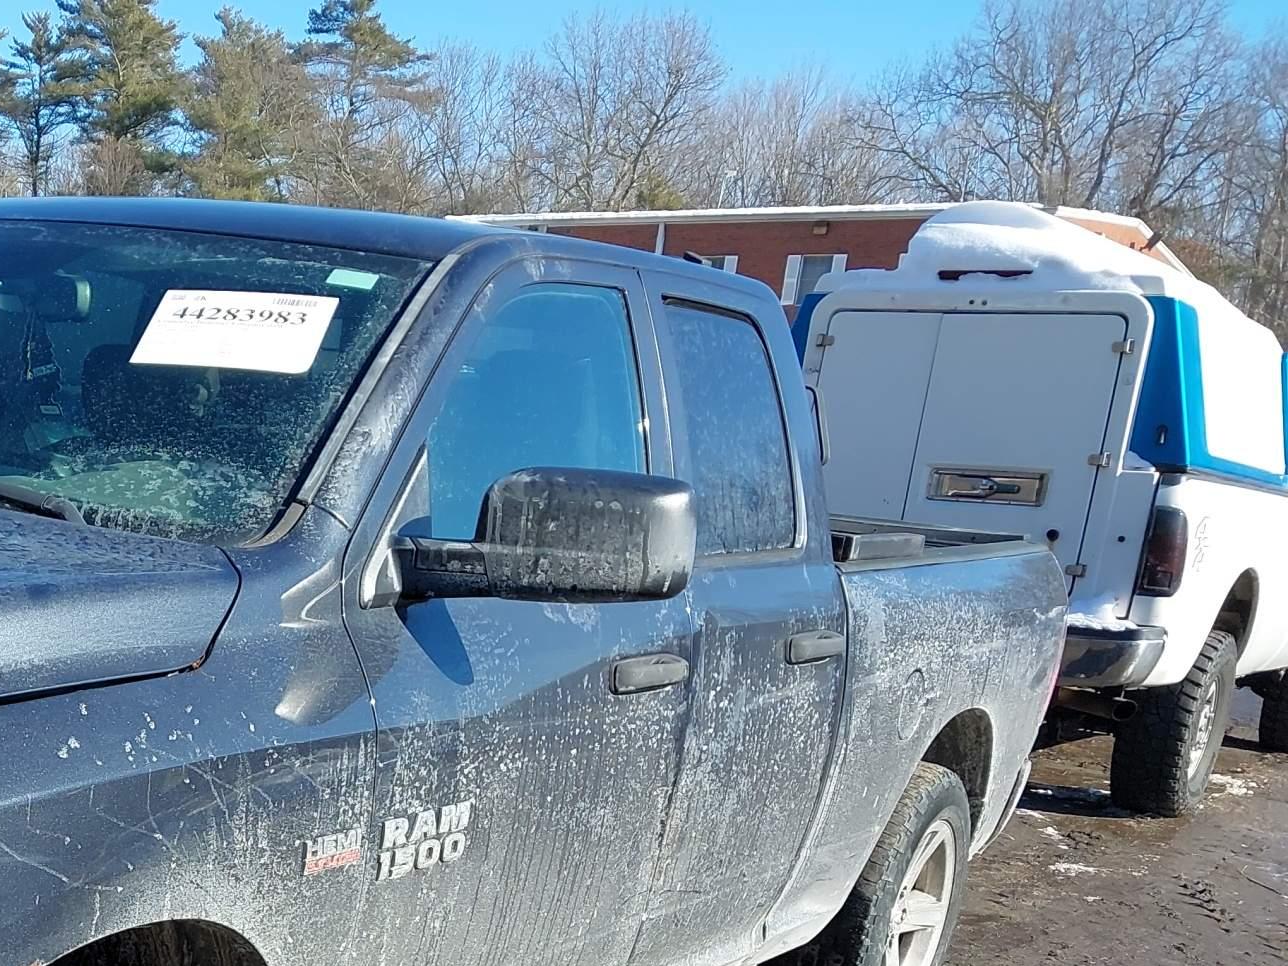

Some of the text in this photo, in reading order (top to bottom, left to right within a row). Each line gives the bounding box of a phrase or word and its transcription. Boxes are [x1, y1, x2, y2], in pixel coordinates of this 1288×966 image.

[172, 306, 308, 326] 44283983
[380, 799, 475, 850] RAM
[376, 832, 466, 881] 1500
